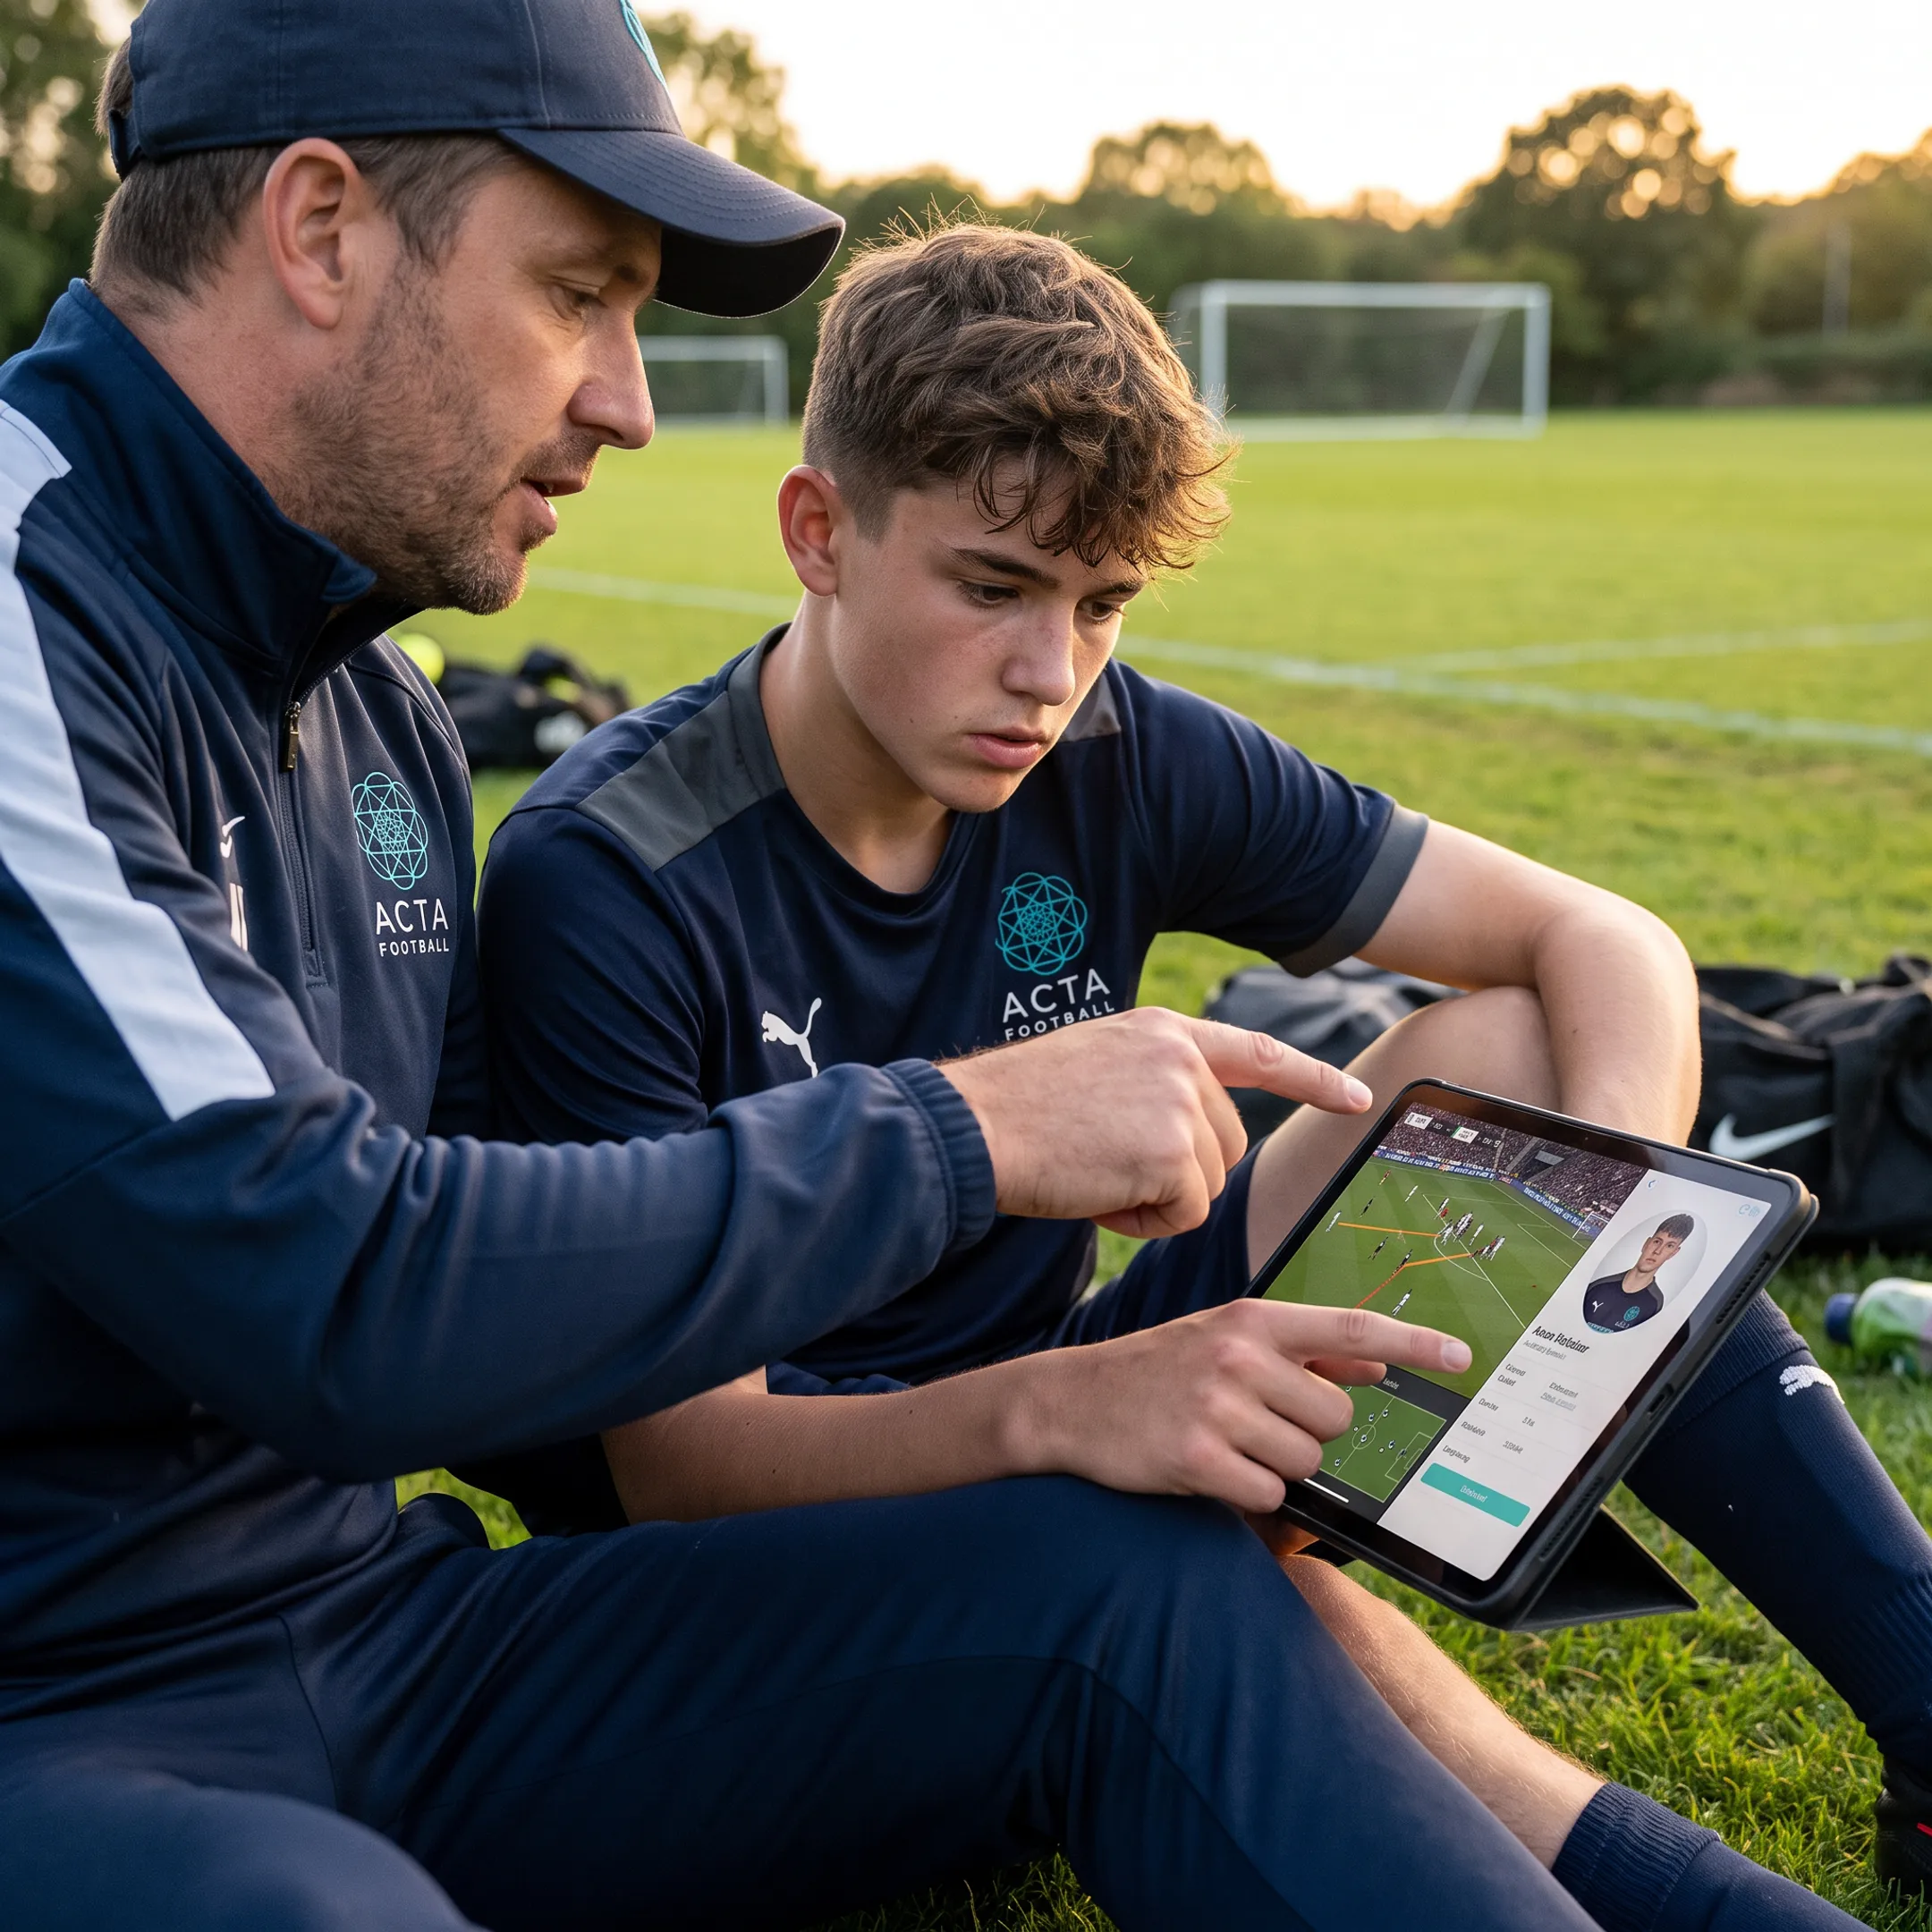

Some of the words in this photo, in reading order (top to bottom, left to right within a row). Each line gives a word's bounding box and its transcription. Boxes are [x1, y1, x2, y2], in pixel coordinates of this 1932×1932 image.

[375, 898, 449, 936] ACTA
[378, 937, 450, 957] FOOTBALL
[1003, 968, 1111, 1023] ACTA
[1004, 1001, 1115, 1041] FOOTBALL
